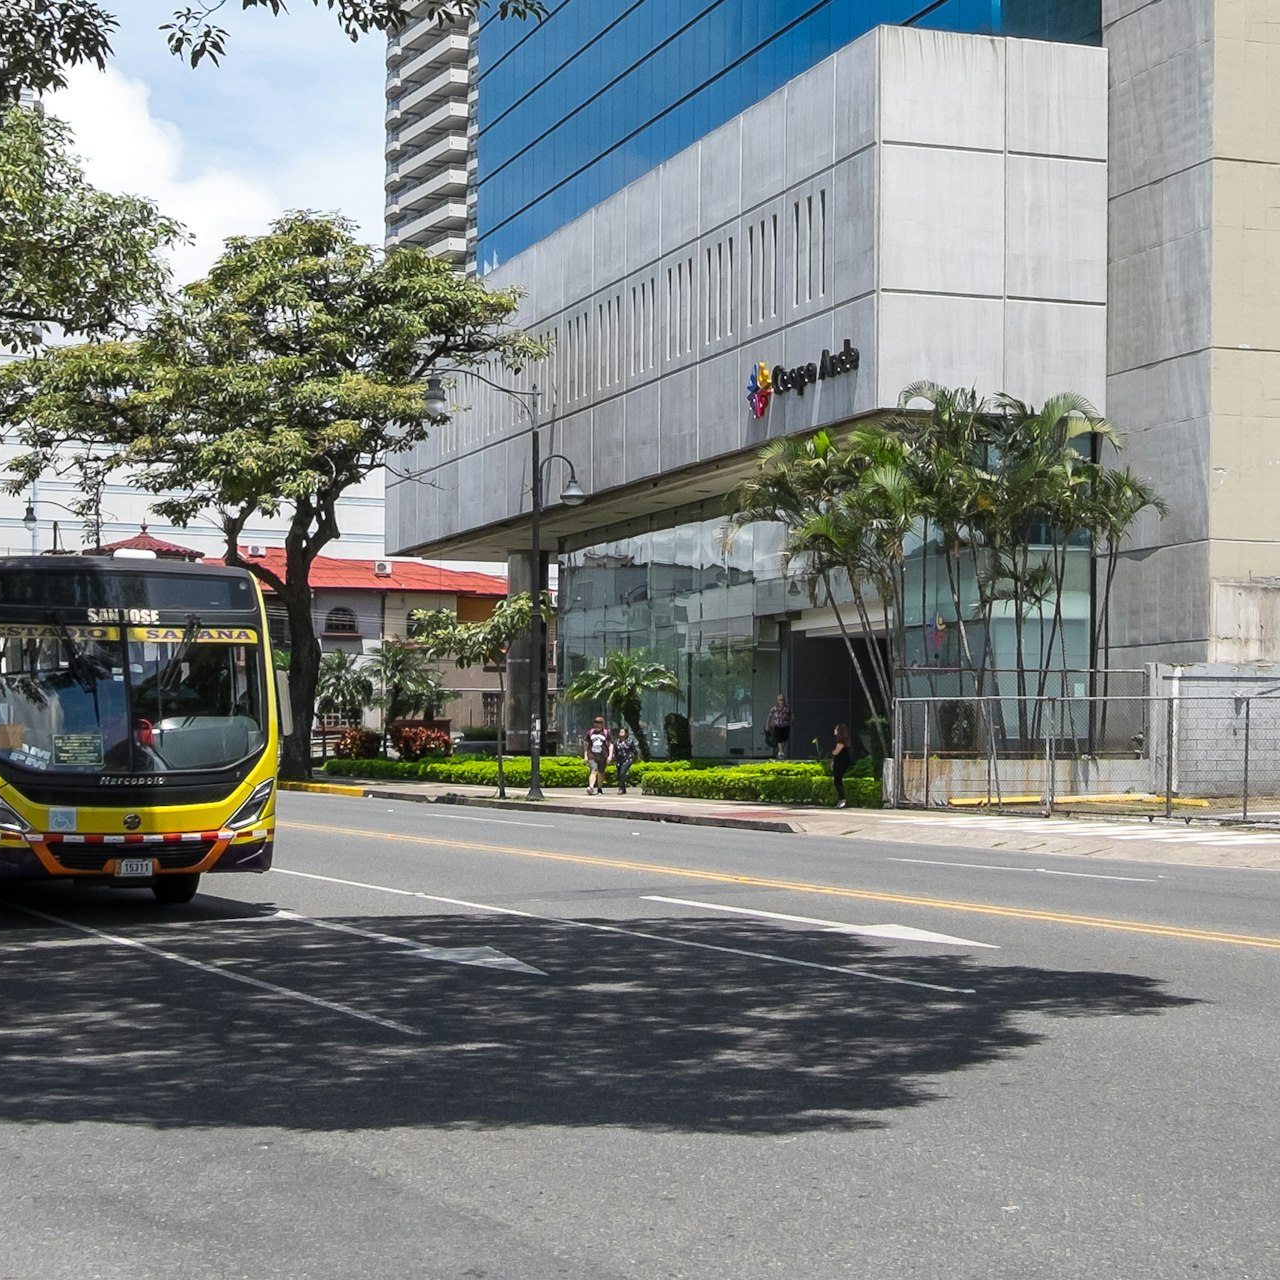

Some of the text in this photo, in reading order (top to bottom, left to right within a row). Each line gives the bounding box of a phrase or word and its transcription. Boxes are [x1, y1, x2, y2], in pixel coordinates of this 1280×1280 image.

[87, 608, 119, 624] SAN
[146, 629, 253, 640] SAANA
[100, 776, 165, 785] Marcopolo
